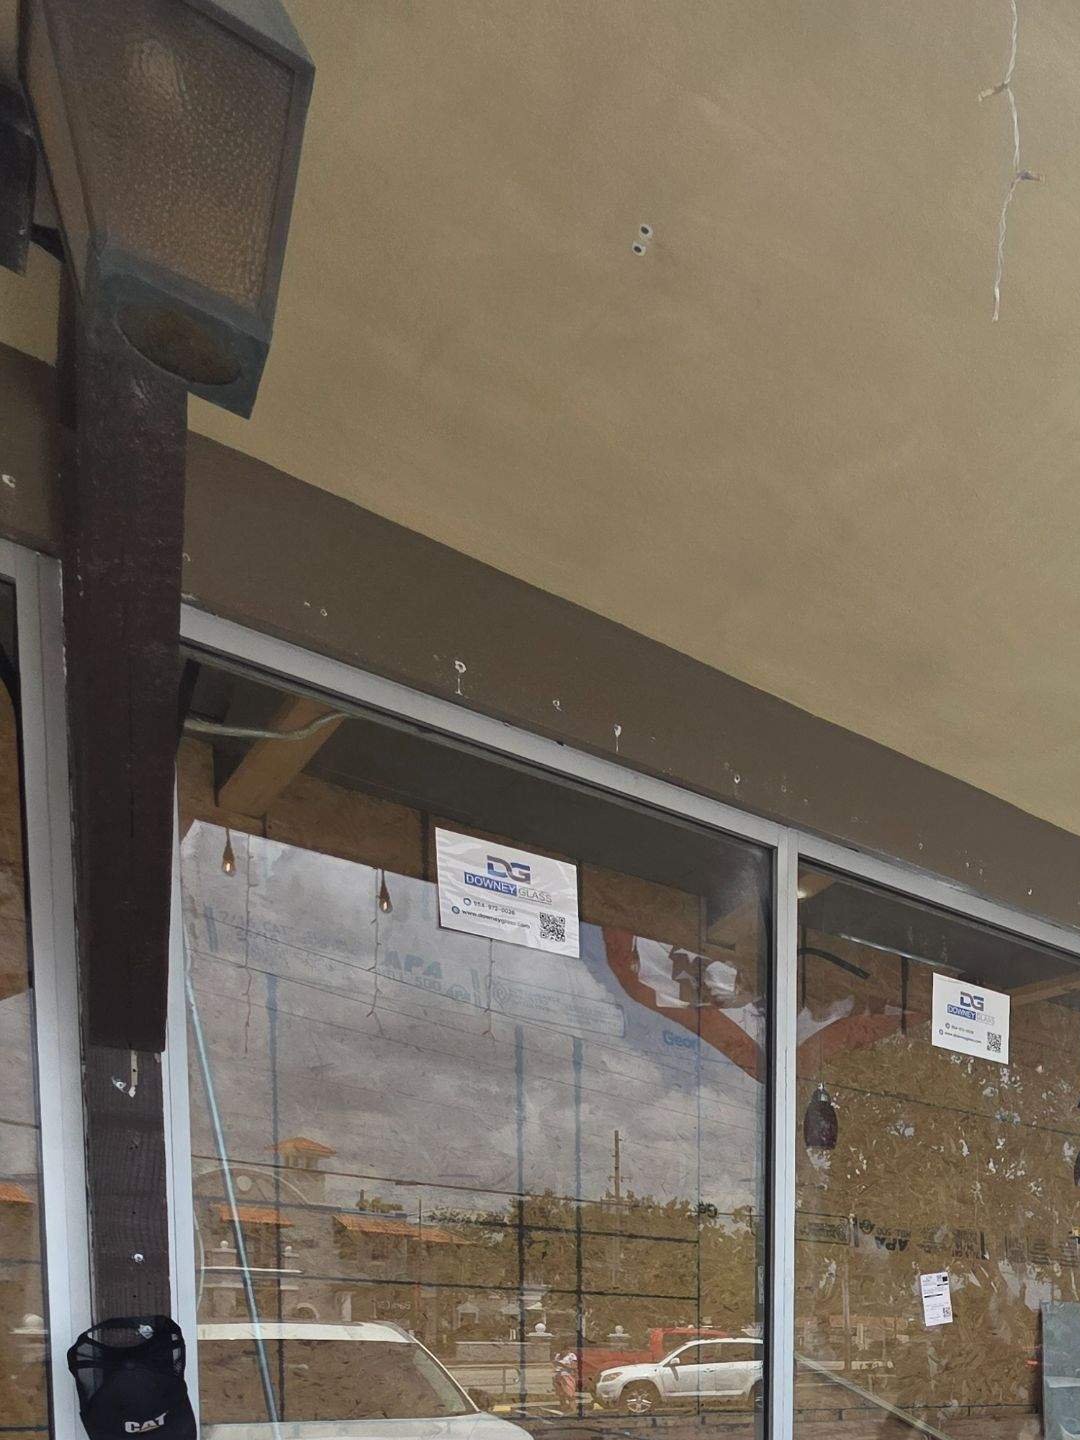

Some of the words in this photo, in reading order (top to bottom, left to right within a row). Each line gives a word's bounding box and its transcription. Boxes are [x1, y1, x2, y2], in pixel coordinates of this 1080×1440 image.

[486, 854, 531, 885] DG
[465, 874, 517, 895] DOWNEY
[518, 887, 552, 905] GLASS
[947, 1005, 976, 1020] DOWNEY
[959, 991, 985, 1012] DG
[124, 1412, 168, 1434] CAT
